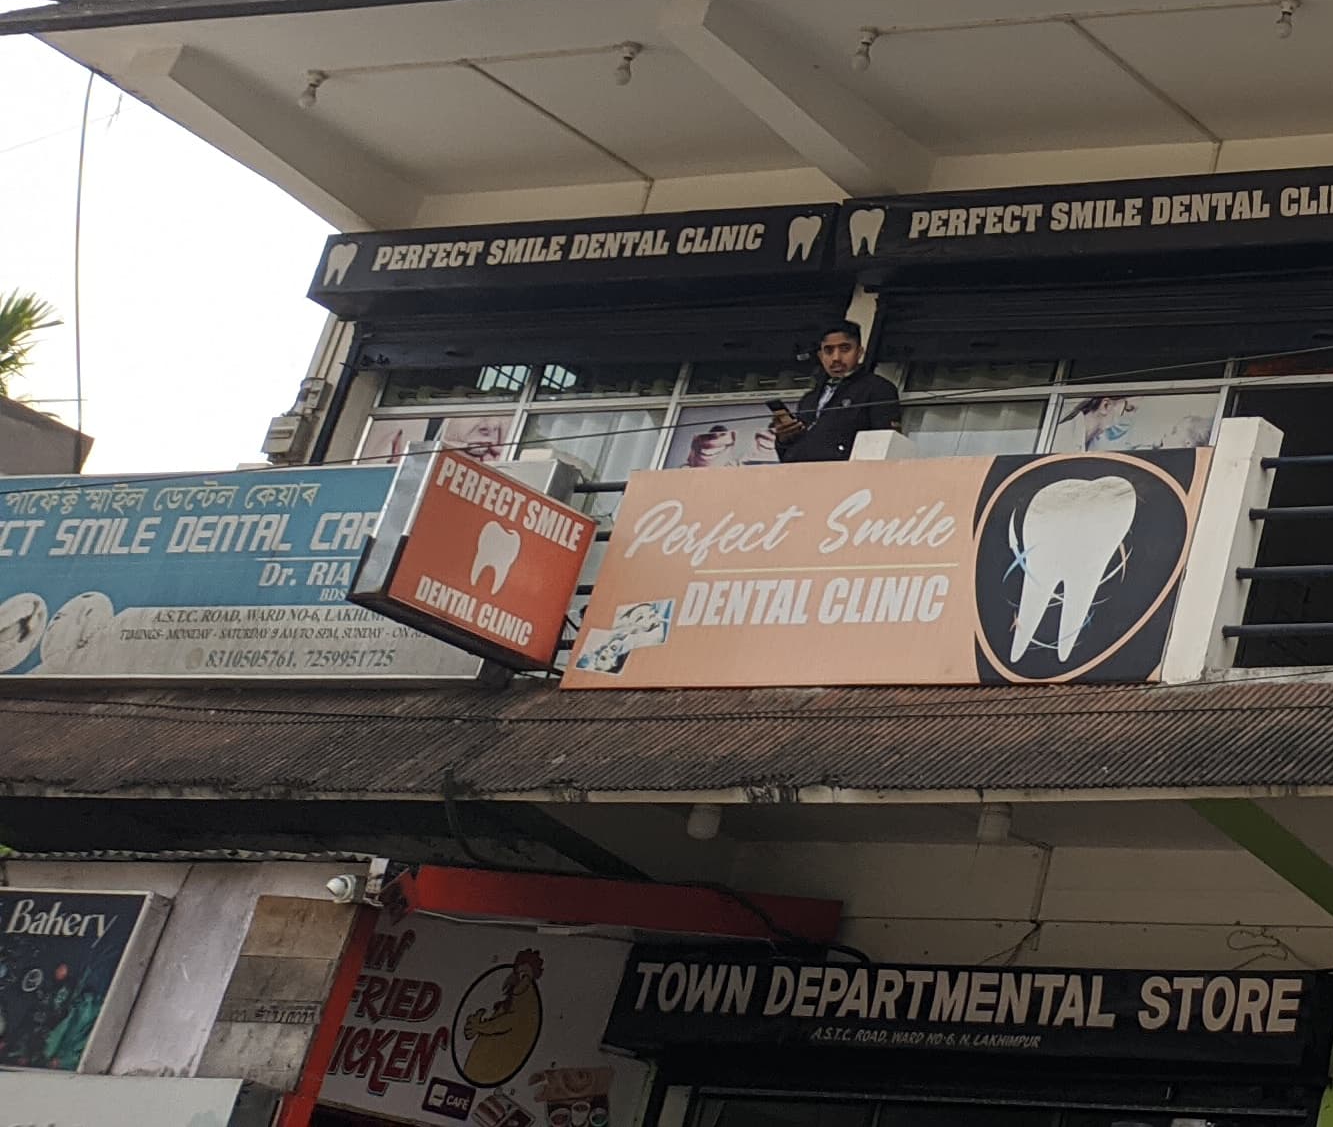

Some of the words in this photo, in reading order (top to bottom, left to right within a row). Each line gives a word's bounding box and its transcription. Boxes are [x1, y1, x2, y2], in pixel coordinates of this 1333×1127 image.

[907, 204, 1042, 239] PERFECT
[1050, 198, 1142, 232] SMILE
[1150, 189, 1271, 226] DENTAL
[372, 241, 483, 271] PERFECT
[486, 235, 563, 266] SMILE
[569, 228, 670, 261] DENTAL
[676, 223, 765, 254] CLINIC
[437, 456, 522, 518] PERFECT
[523, 500, 584, 553] SMILE
[624, 500, 803, 566] Perfect
[818, 488, 957, 554] Smile
[48, 516, 162, 556] SMILE
[166, 513, 292, 554] DENTAL
[258, 562, 297, 586] Dr.
[306, 561, 352, 586] RIA
[246, 608, 285, 622] WARD
[415, 575, 477, 627] DENTAL
[476, 598, 534, 647] CLINIC
[676, 579, 811, 627] DENTAL
[817, 574, 950, 624] CLINIC
[5, 898, 119, 949] Bakery
[633, 962, 757, 1015] TOWN
[762, 965, 1116, 1030] DEPARTMENTAL
[1136, 975, 1302, 1033] STORE
[891, 1031, 923, 1045] WARD
